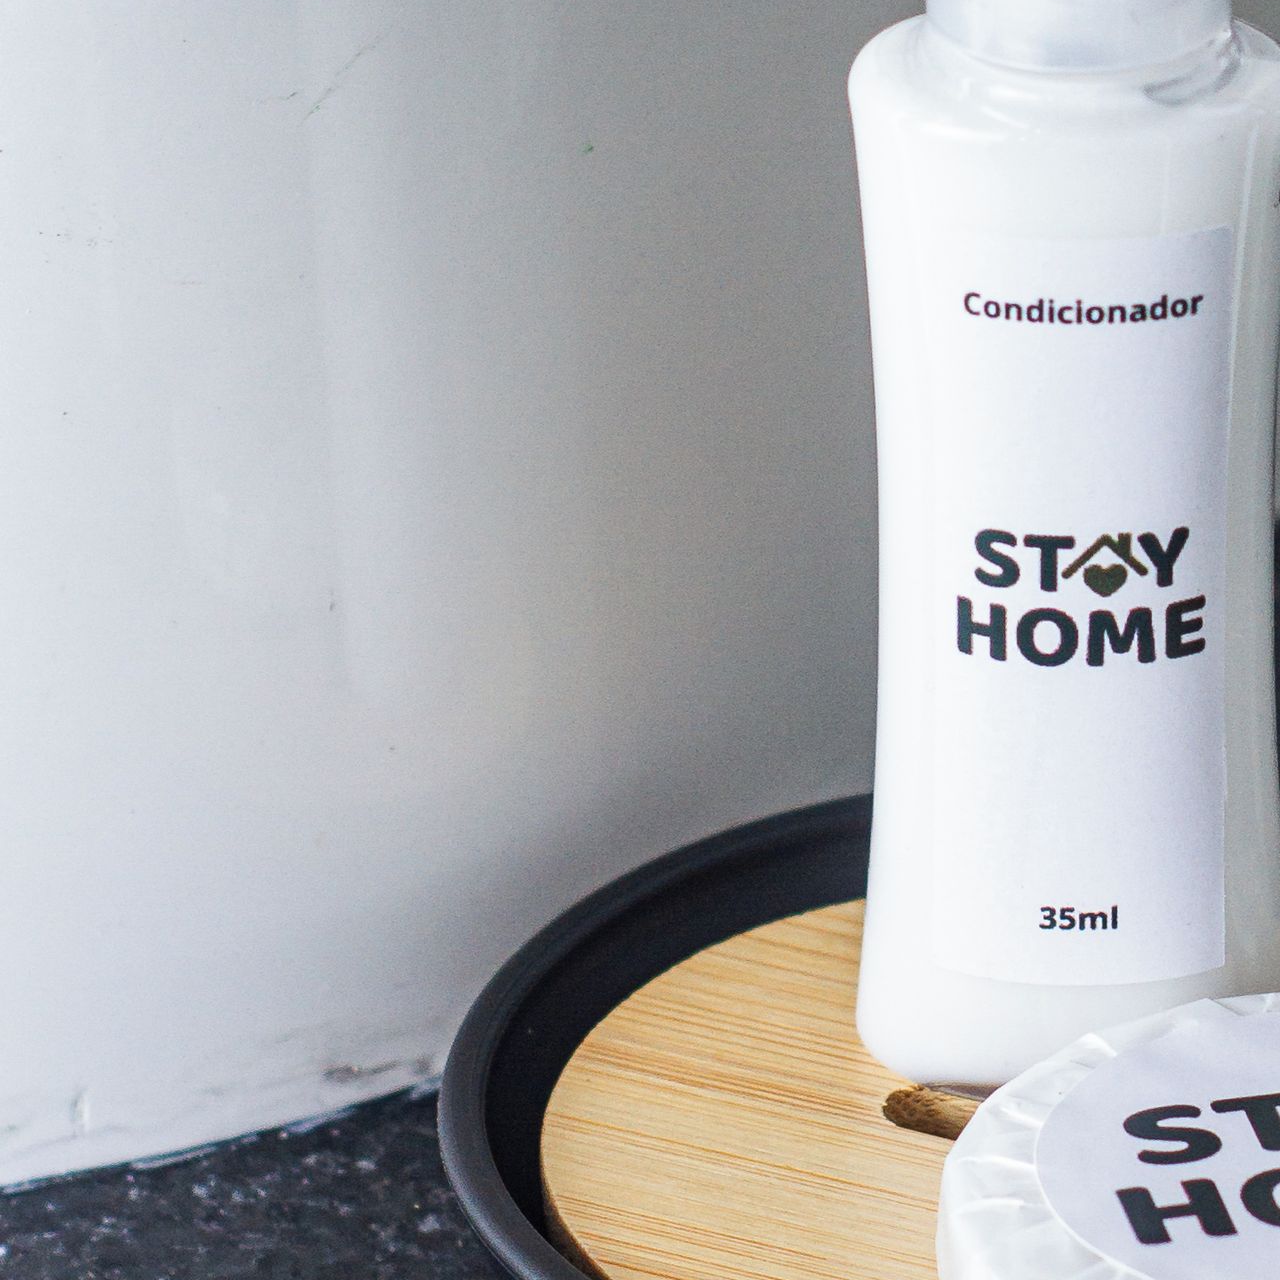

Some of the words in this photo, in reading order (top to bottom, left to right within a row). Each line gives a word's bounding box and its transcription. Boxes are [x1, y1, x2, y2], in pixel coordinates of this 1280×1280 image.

[964, 292, 1204, 326] Condicionador
[974, 526, 1190, 598] STAY
[956, 594, 1207, 667] HOME
[1039, 906, 1118, 931] 35ml
